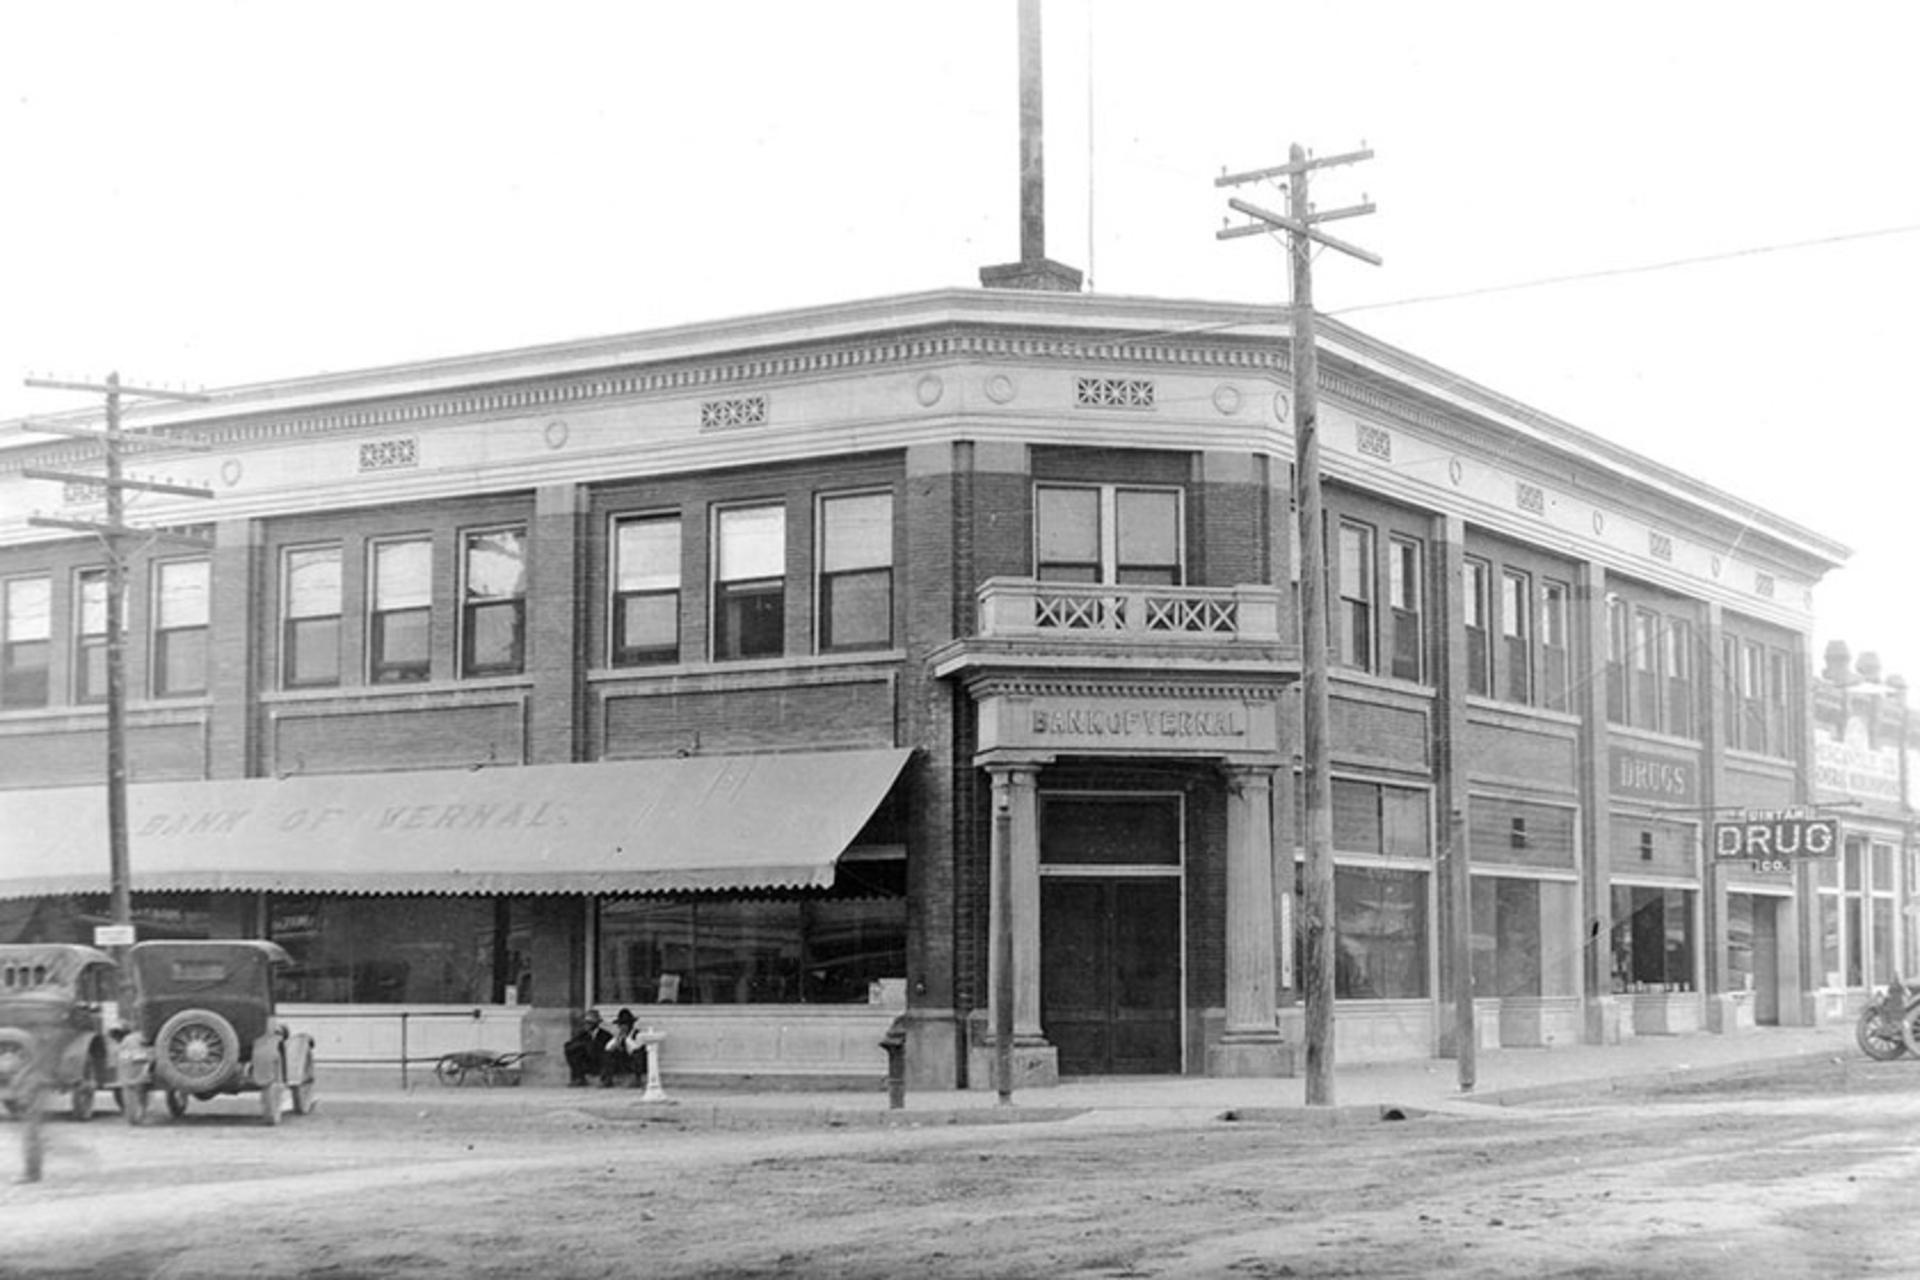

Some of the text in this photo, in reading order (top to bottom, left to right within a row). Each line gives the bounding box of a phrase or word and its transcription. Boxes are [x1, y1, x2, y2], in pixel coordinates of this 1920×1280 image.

[1032, 709, 1245, 737] BANK OF VERNAL
[1620, 756, 1685, 795] DRUGS
[137, 807, 252, 837] BANK
[278, 807, 345, 832] OF
[1718, 823, 1833, 855] DRUG
